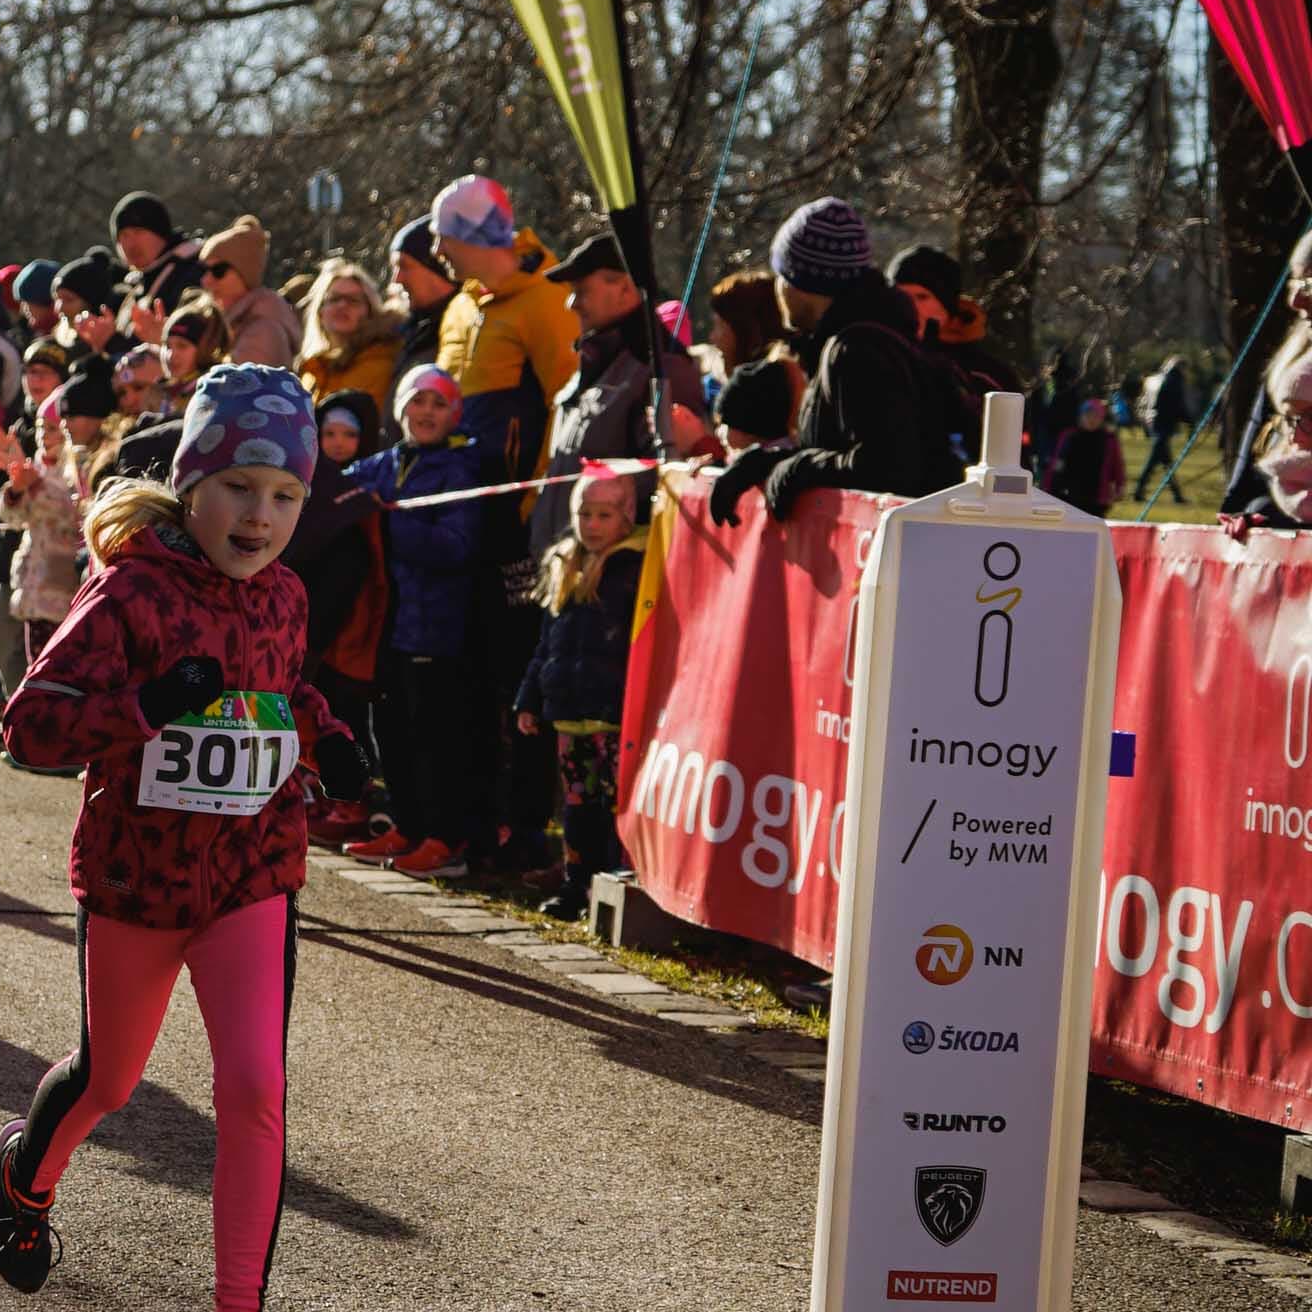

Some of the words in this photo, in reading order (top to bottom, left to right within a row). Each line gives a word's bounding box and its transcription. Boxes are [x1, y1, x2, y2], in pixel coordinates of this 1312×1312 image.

[816, 698, 851, 743] inno
[155, 729, 282, 789] 3011
[909, 727, 1058, 778] innogy
[951, 811, 1052, 837] Powered
[948, 839, 978, 867] by
[988, 842, 1049, 865] MVM
[984, 946, 1024, 968] NN
[937, 1024, 1021, 1054] ŠKODA
[923, 1112, 1007, 1134] RUNTO
[922, 1173, 980, 1182] PEUGEOT
[894, 1276, 992, 1297] NUTREND
